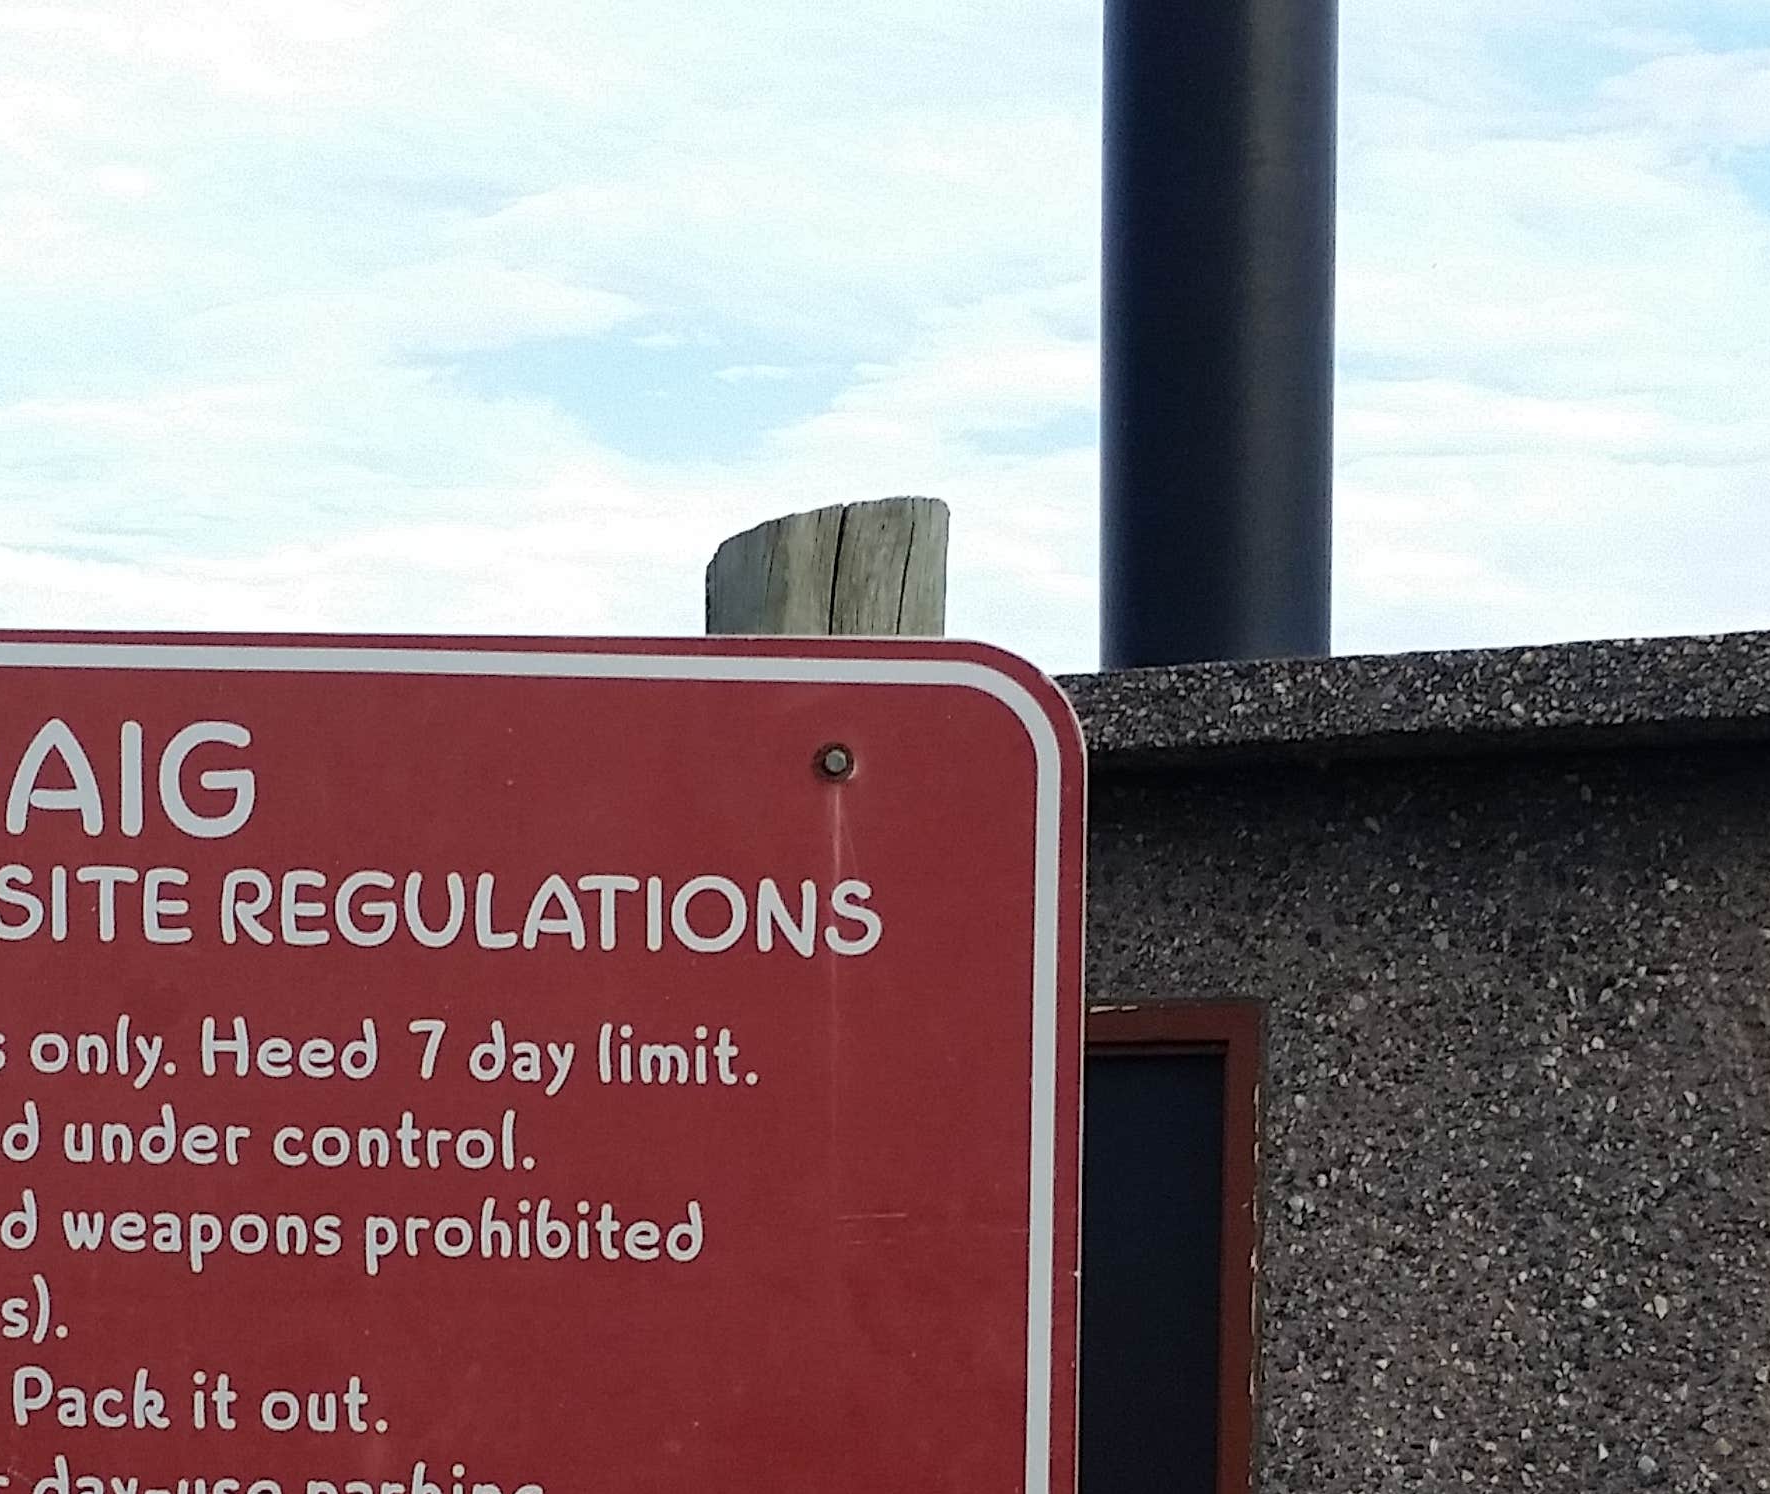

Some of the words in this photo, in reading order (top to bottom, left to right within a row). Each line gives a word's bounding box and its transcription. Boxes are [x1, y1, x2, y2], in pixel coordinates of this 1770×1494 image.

[220, 867, 883, 959] REGULATIONS
[29, 1013, 177, 1090] only.
[200, 1015, 378, 1080] Heed
[408, 1018, 447, 1081] 7
[468, 1019, 576, 1097] day
[598, 1021, 759, 1086] limit.
[63, 1102, 252, 1166] under
[272, 1108, 536, 1171] control.
[61, 1210, 343, 1274] weapons
[364, 1196, 704, 1277] prohibited
[12, 1365, 171, 1430] Pack
[192, 1370, 238, 1431] it
[260, 1375, 389, 1434] out.
